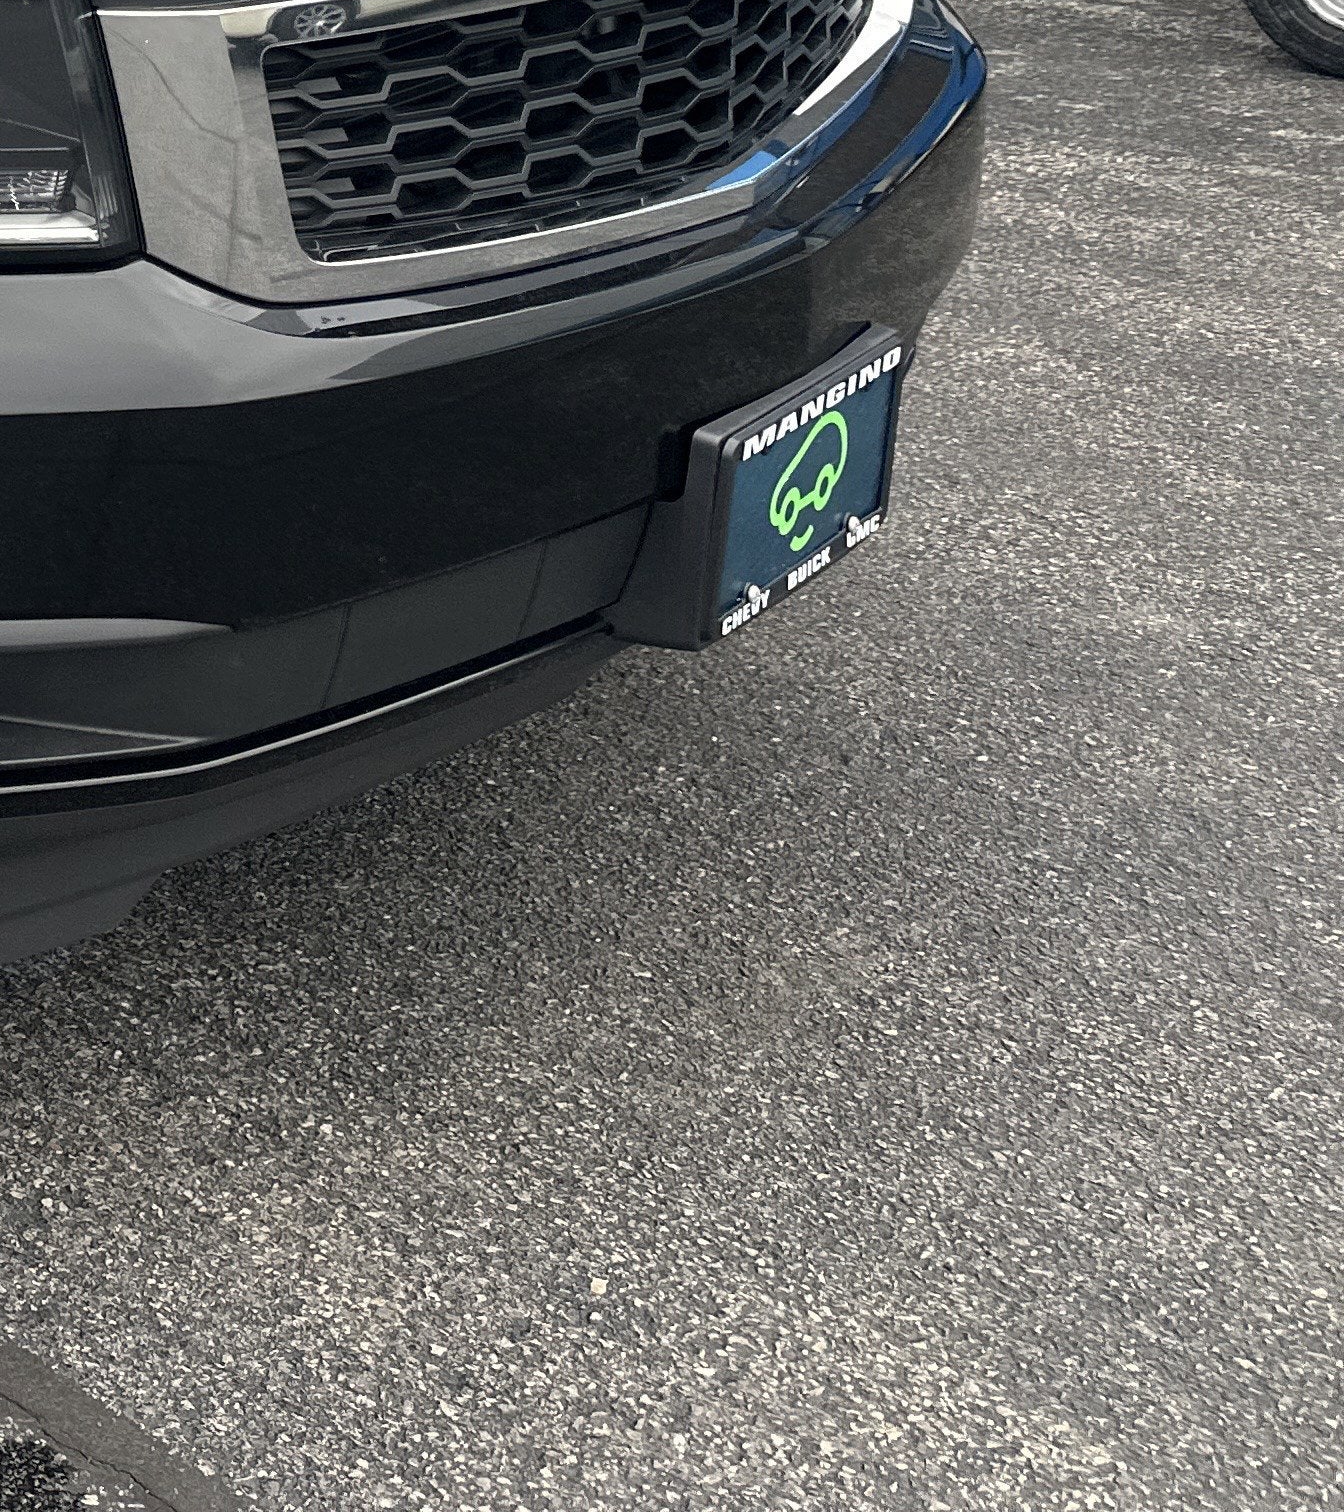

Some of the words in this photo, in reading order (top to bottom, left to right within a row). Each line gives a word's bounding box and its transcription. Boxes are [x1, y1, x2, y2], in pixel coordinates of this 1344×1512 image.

[742, 347, 901, 461] MANGINO
[721, 589, 771, 636] CHEVY
[787, 546, 832, 591] BUICK
